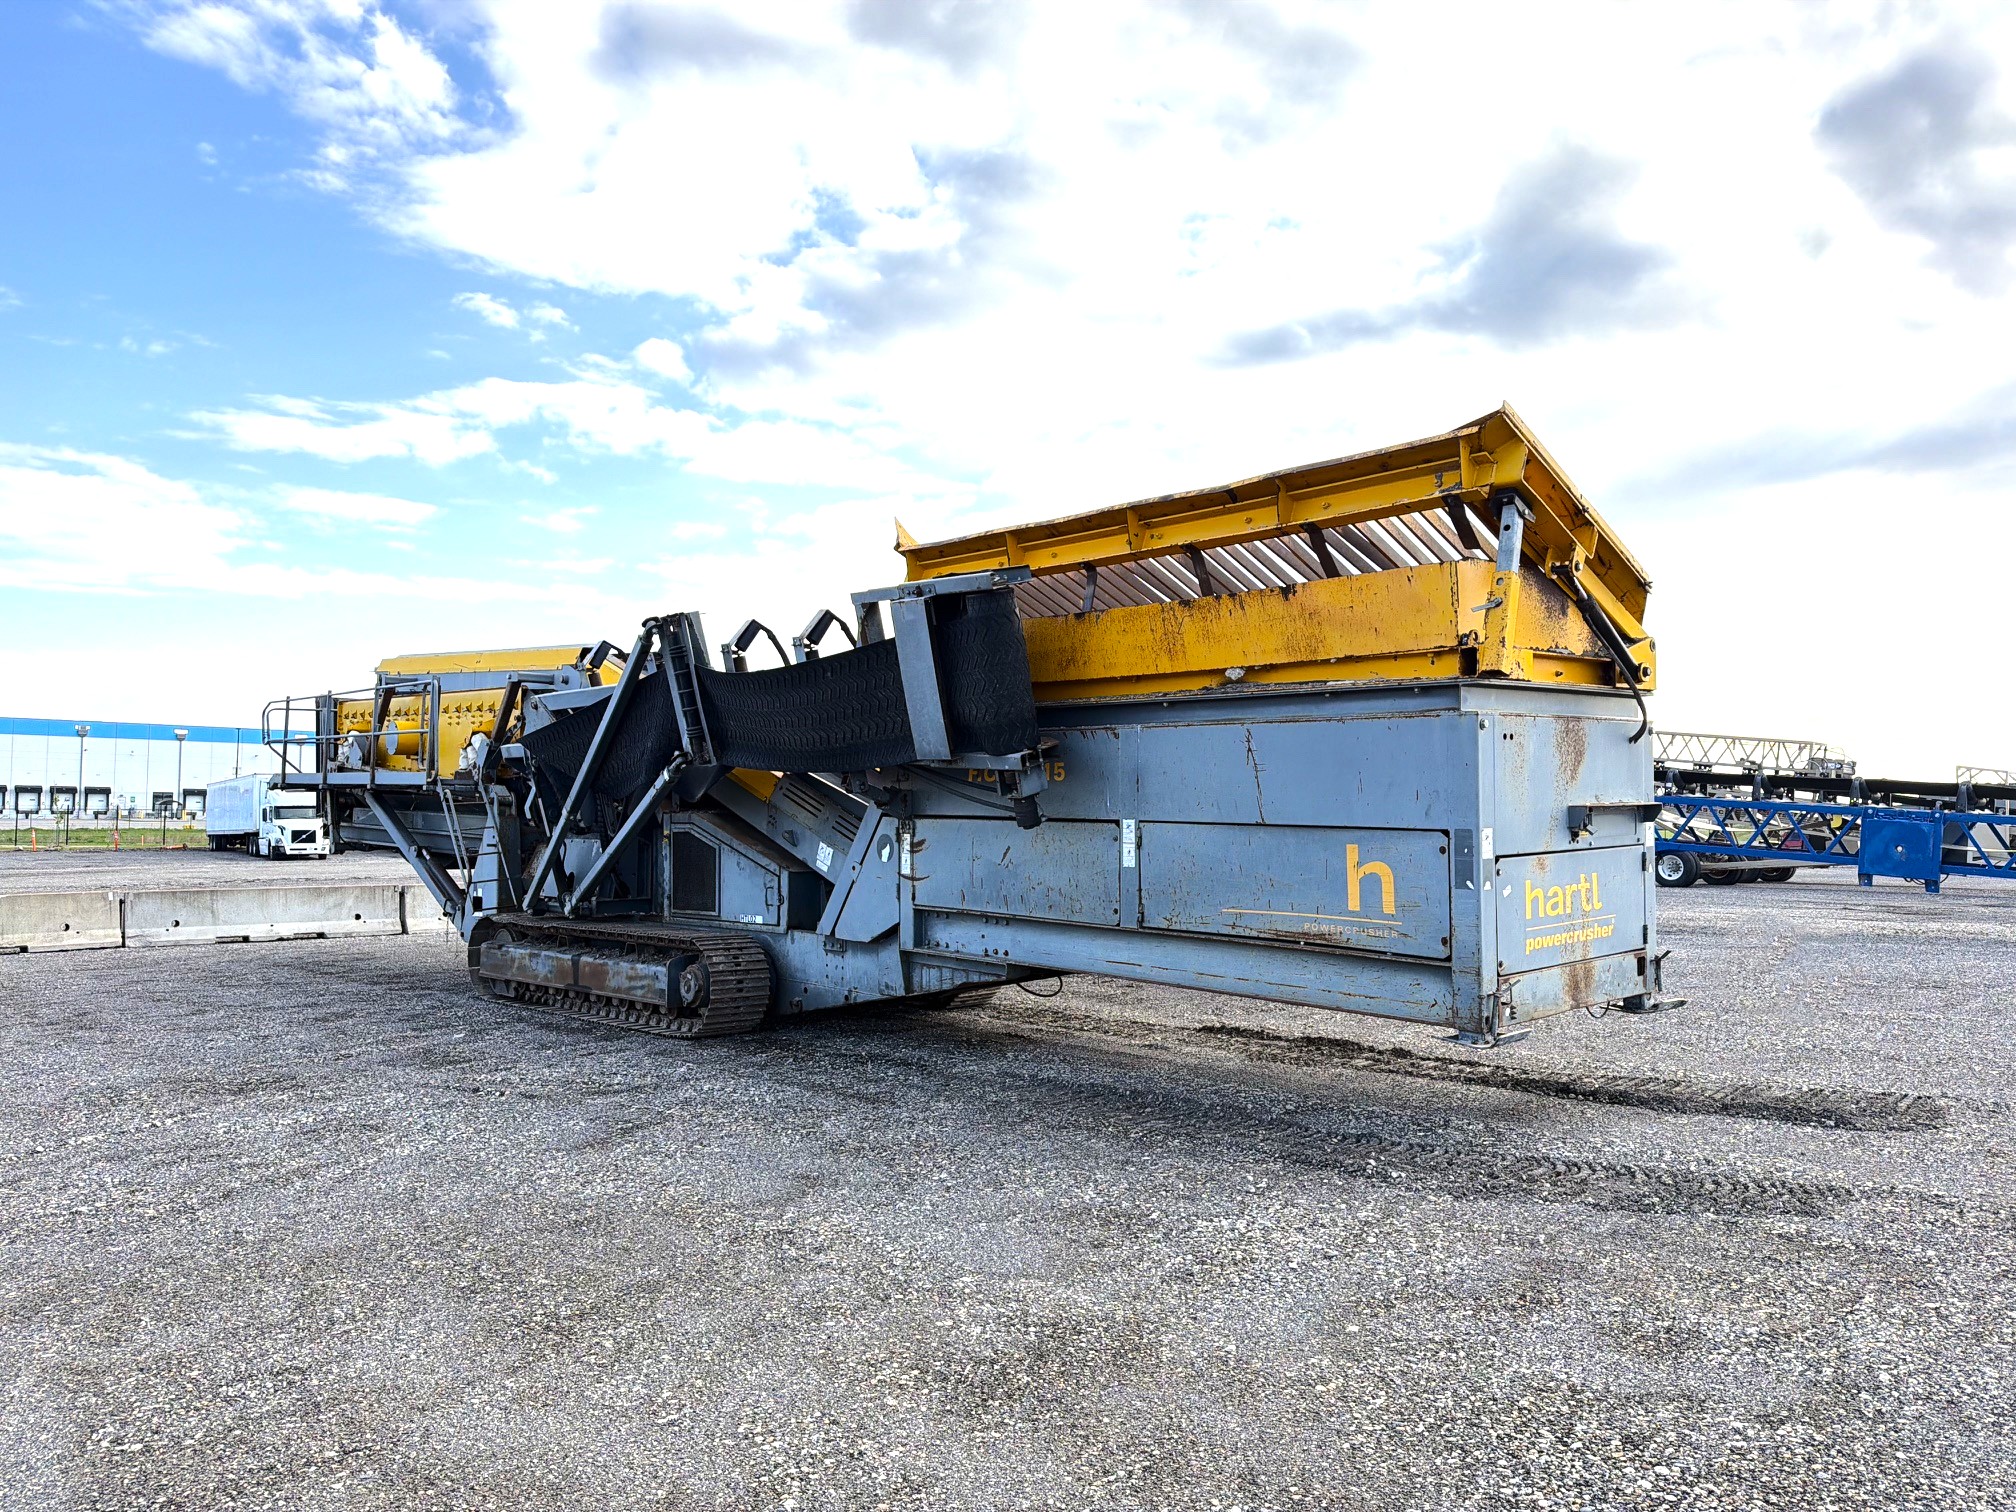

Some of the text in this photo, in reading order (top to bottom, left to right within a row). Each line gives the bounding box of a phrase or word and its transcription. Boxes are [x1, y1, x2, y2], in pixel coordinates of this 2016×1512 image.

[1346, 844, 1396, 914] h
[1525, 872, 1603, 920] hartl
[1303, 922, 1399, 939] POWERCRUSHER
[1525, 922, 1614, 955] powercrusher
